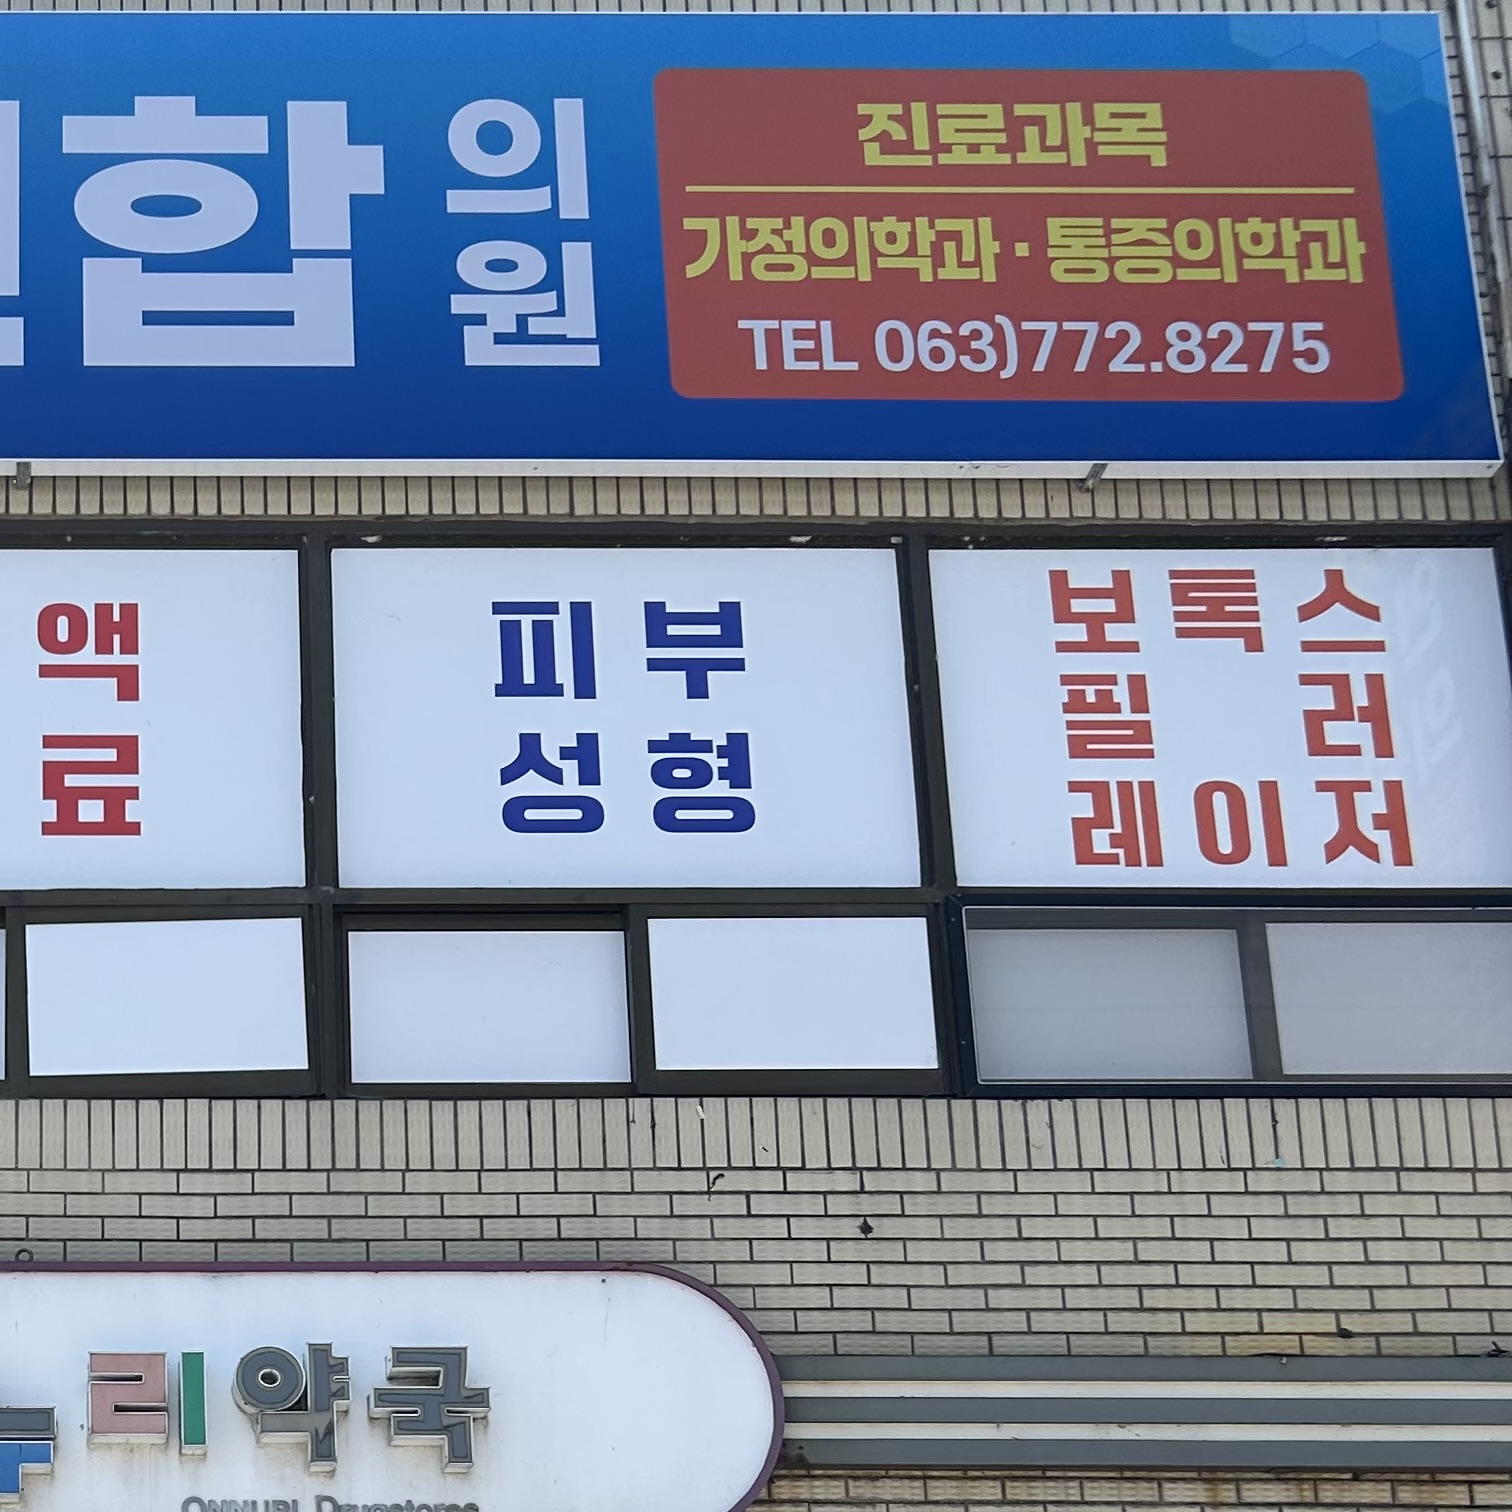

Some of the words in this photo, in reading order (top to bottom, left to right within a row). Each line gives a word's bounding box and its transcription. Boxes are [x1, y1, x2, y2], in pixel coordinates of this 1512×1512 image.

[856, 102, 1168, 167] 진료과목
[446, 97, 601, 367] 의원
[737, 319, 858, 372] TEL
[874, 314, 1331, 379] 063)772.8275
